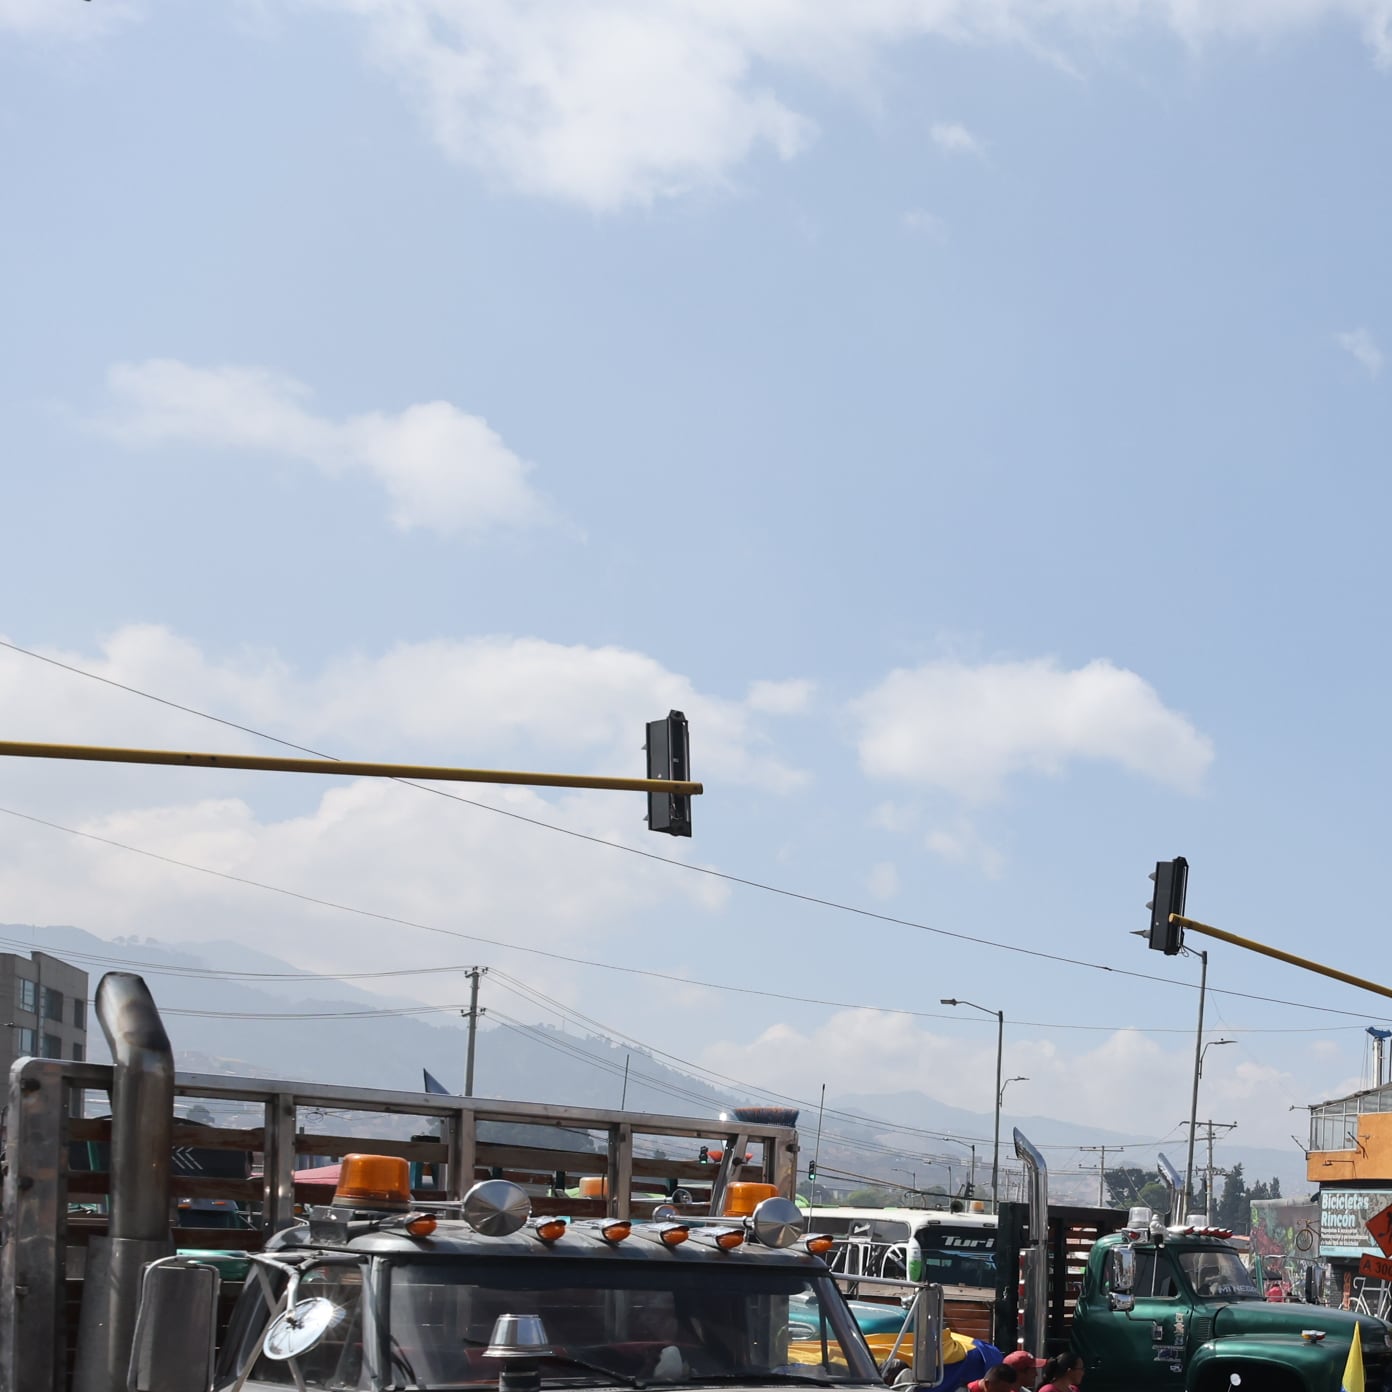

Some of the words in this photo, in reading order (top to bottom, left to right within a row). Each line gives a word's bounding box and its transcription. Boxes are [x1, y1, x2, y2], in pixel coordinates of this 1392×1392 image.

[1321, 1193, 1369, 1210] Bicicletas
[1321, 1210, 1356, 1227] Rincón
[1363, 1260, 1371, 1270] A
